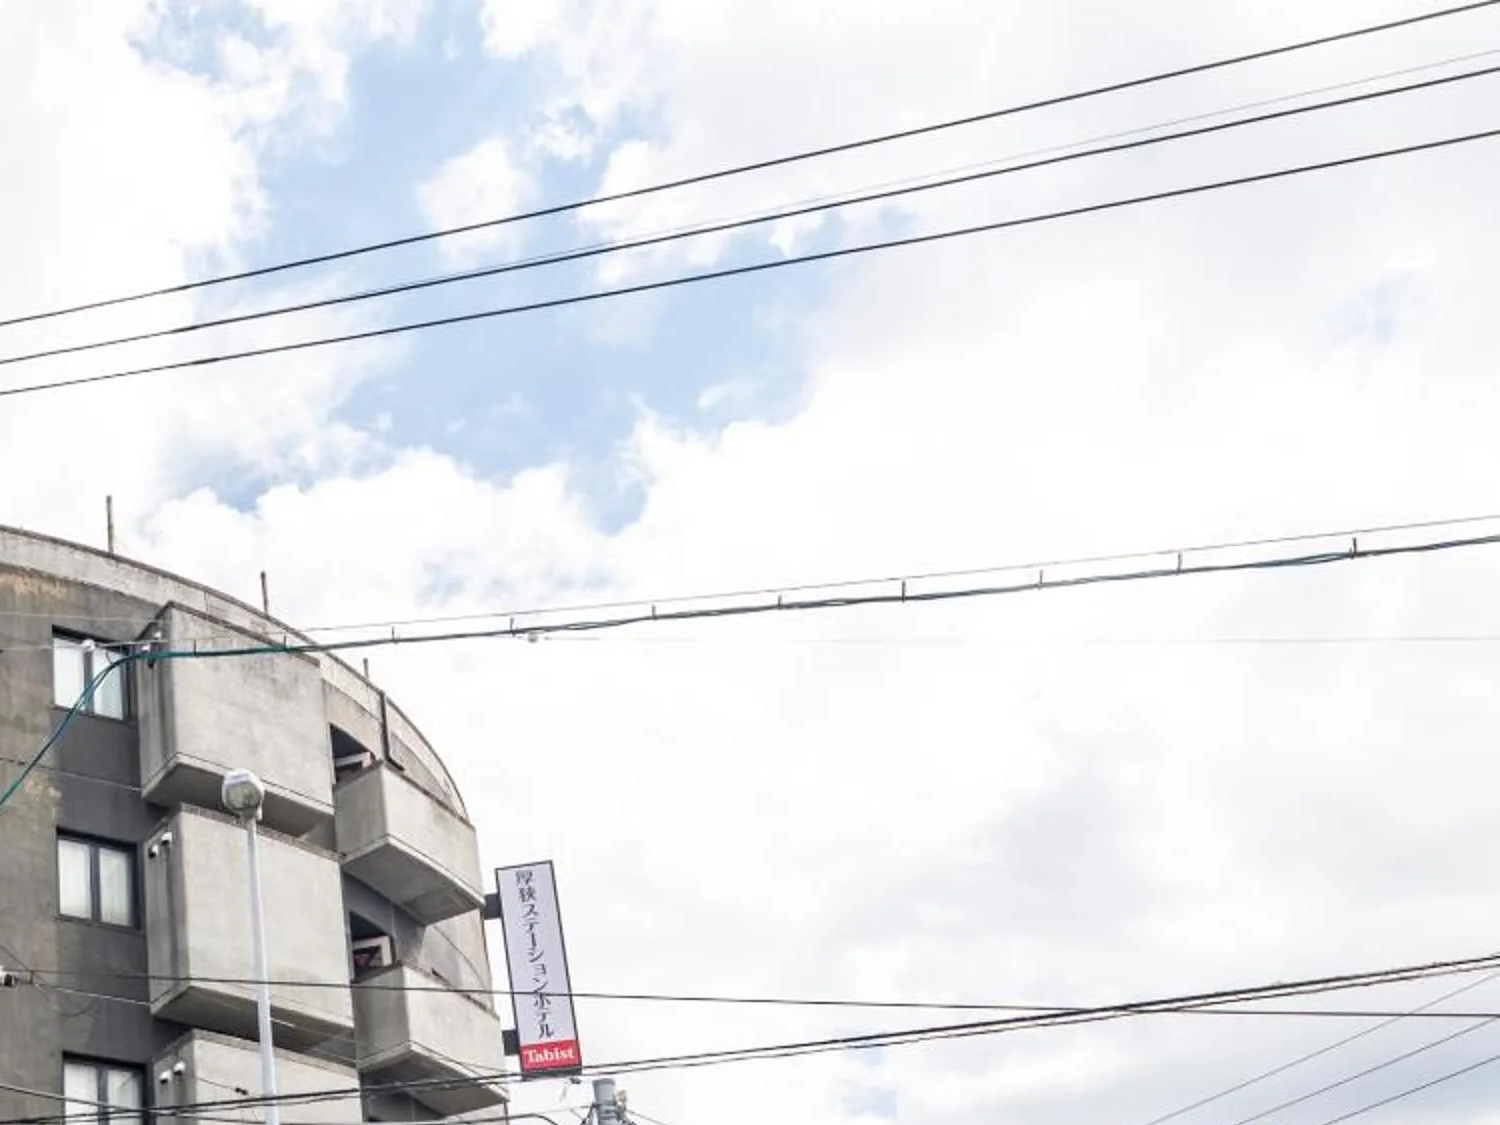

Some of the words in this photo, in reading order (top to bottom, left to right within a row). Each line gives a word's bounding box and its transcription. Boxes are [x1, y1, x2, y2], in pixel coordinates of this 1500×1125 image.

[516, 870, 554, 1038] 厚狭ステーションホテル
[526, 1049, 575, 1063] Tabist
